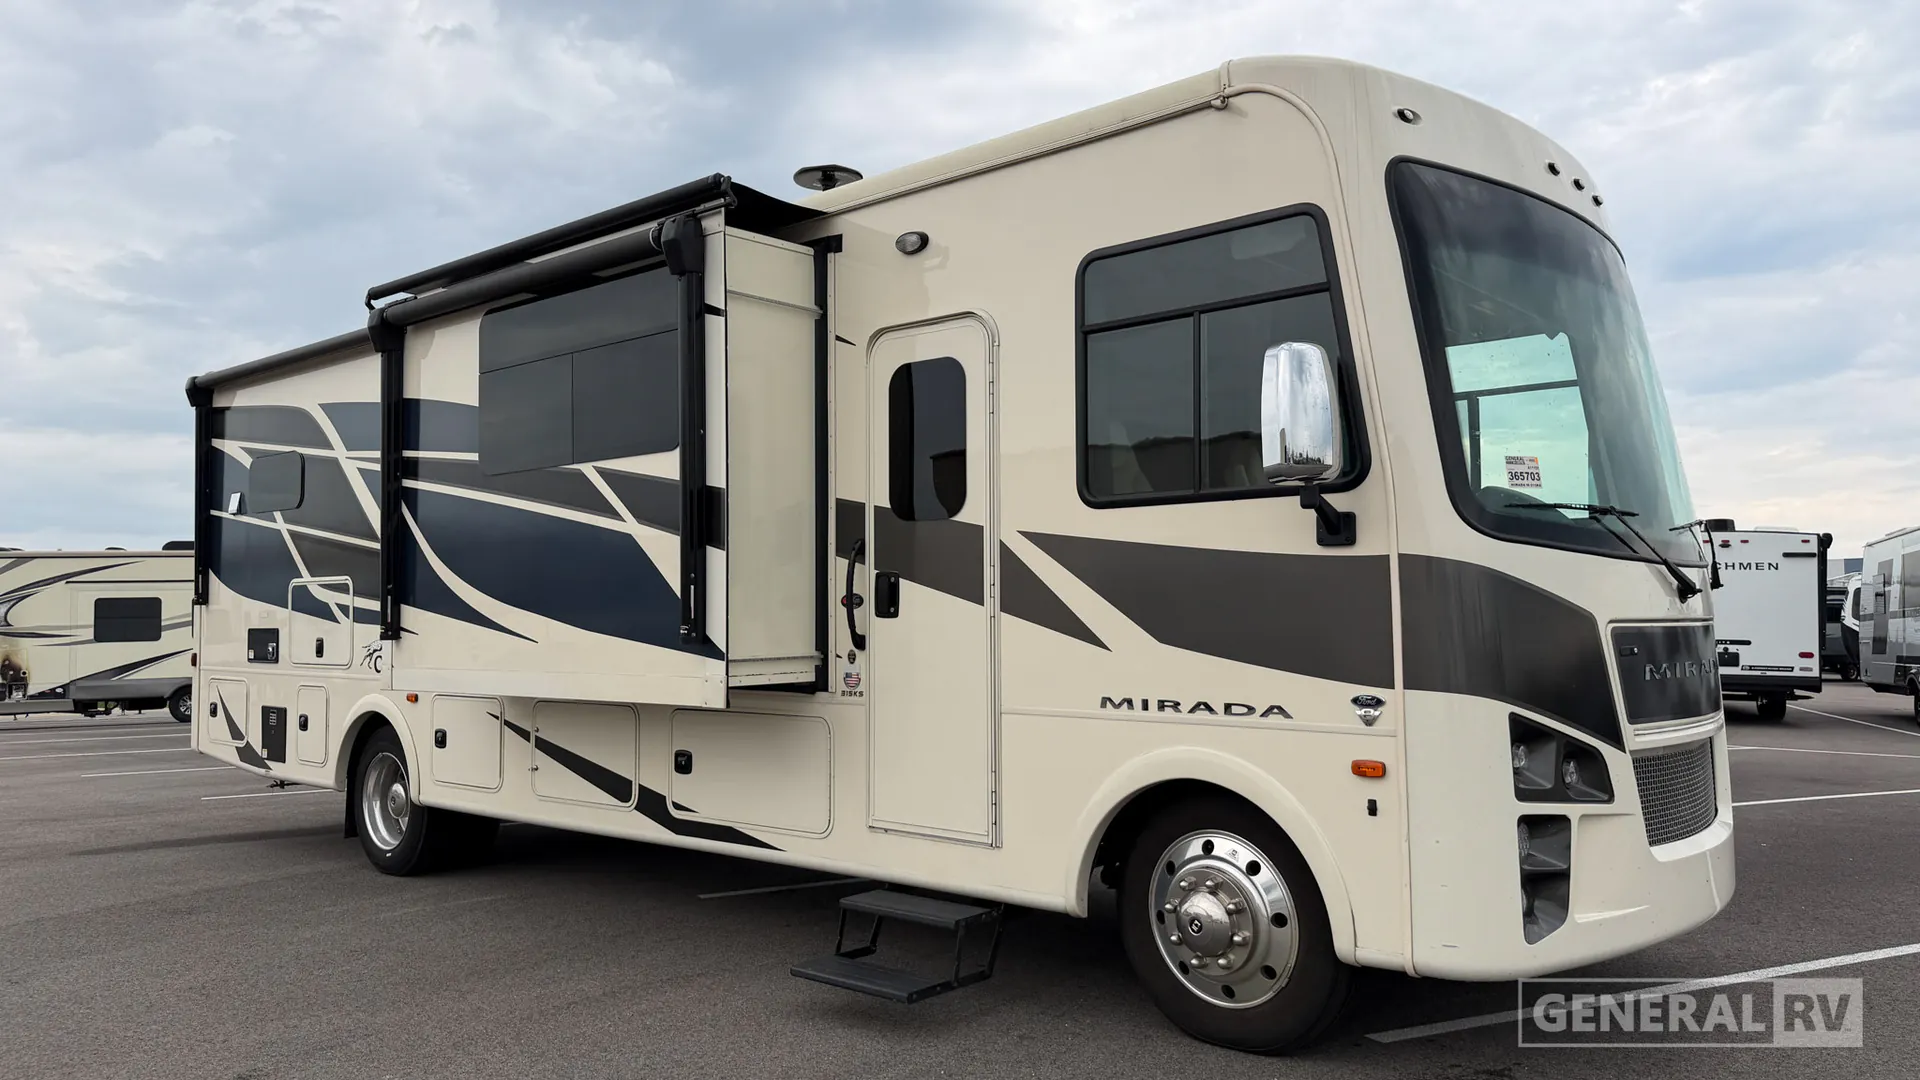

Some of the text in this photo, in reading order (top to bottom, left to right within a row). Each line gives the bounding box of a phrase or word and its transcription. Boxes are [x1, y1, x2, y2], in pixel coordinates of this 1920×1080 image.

[1508, 471, 1541, 481] 365703
[1356, 695, 1377, 705] Ford
[1100, 696, 1294, 719] MIRADA
